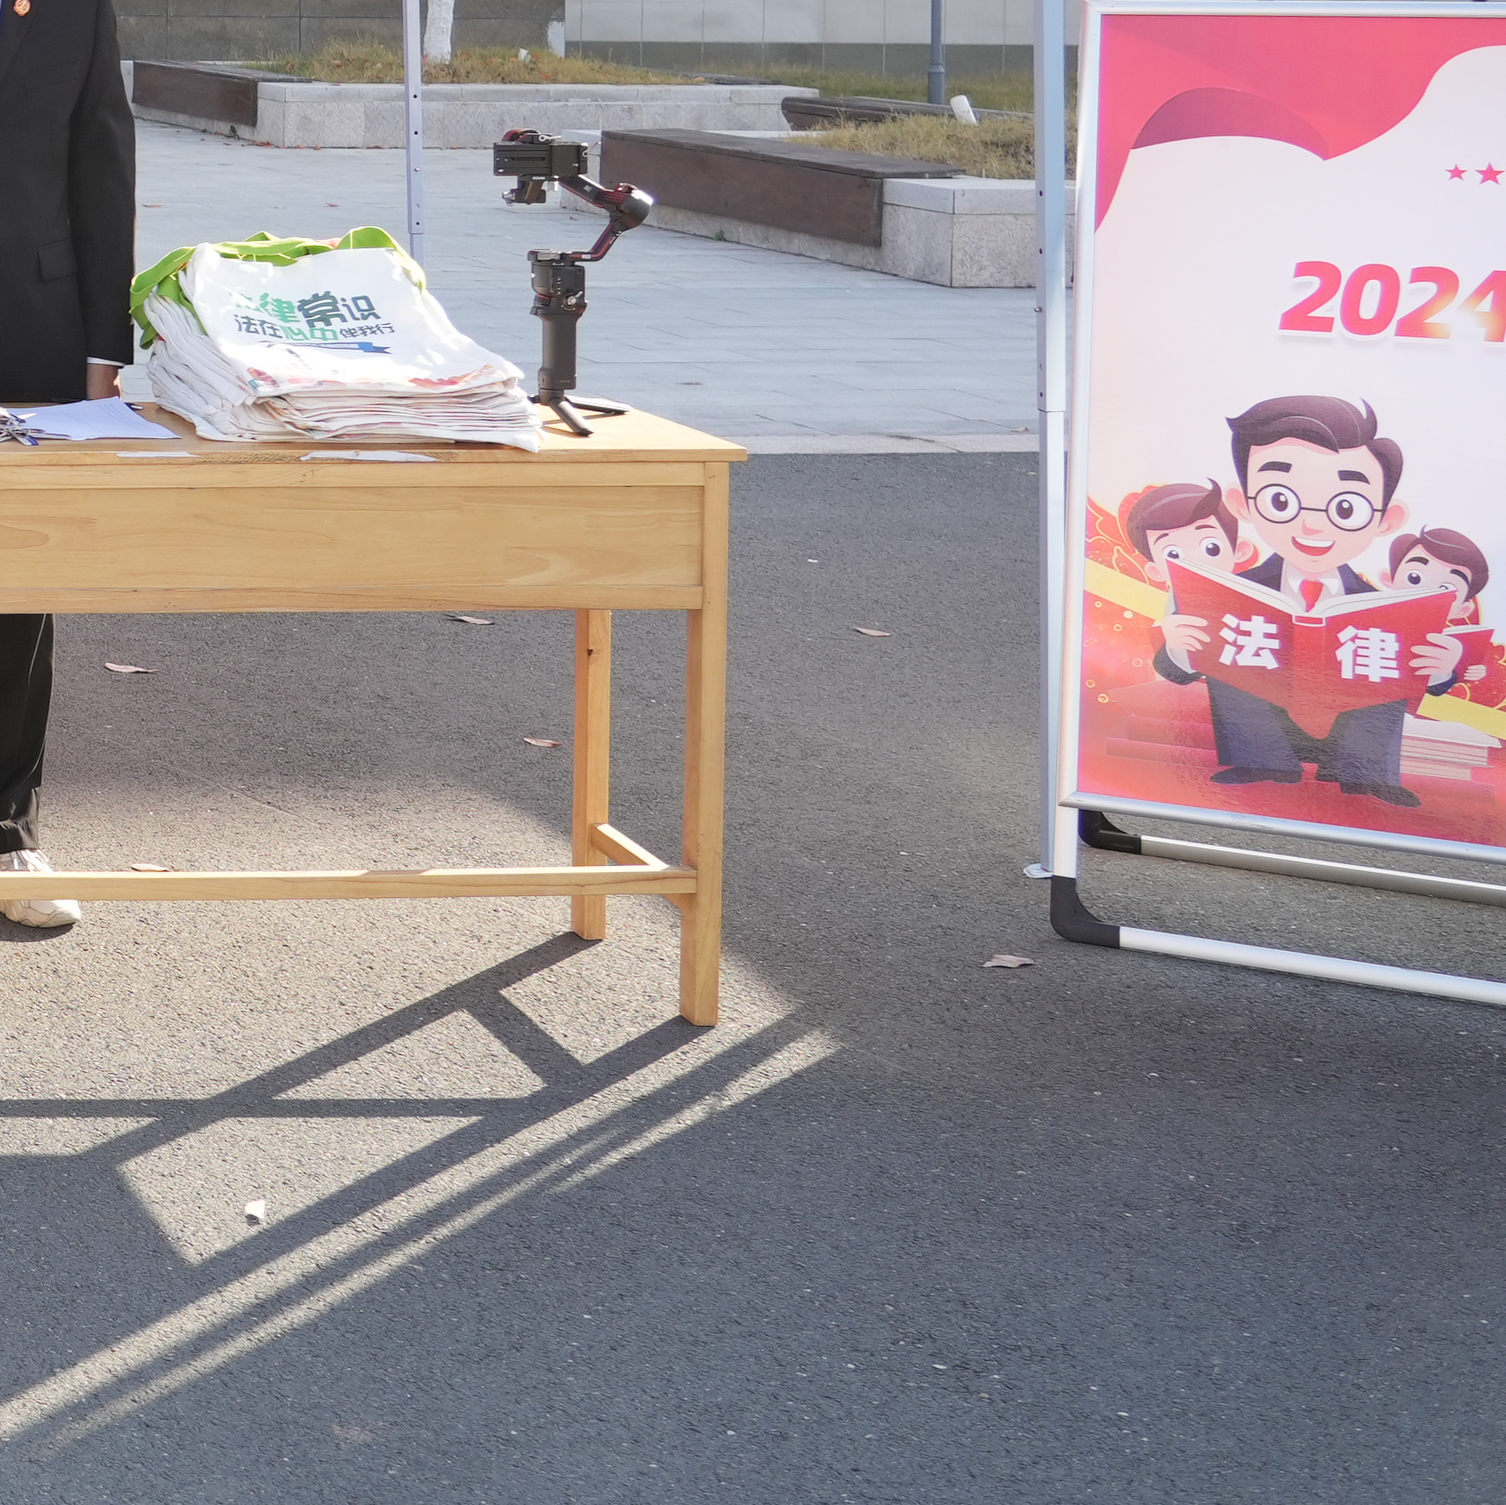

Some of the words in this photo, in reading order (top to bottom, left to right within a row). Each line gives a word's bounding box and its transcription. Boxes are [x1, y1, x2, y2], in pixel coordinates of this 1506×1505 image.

[236, 291, 381, 328] 律常识
[1278, 260, 1506, 343] 2024
